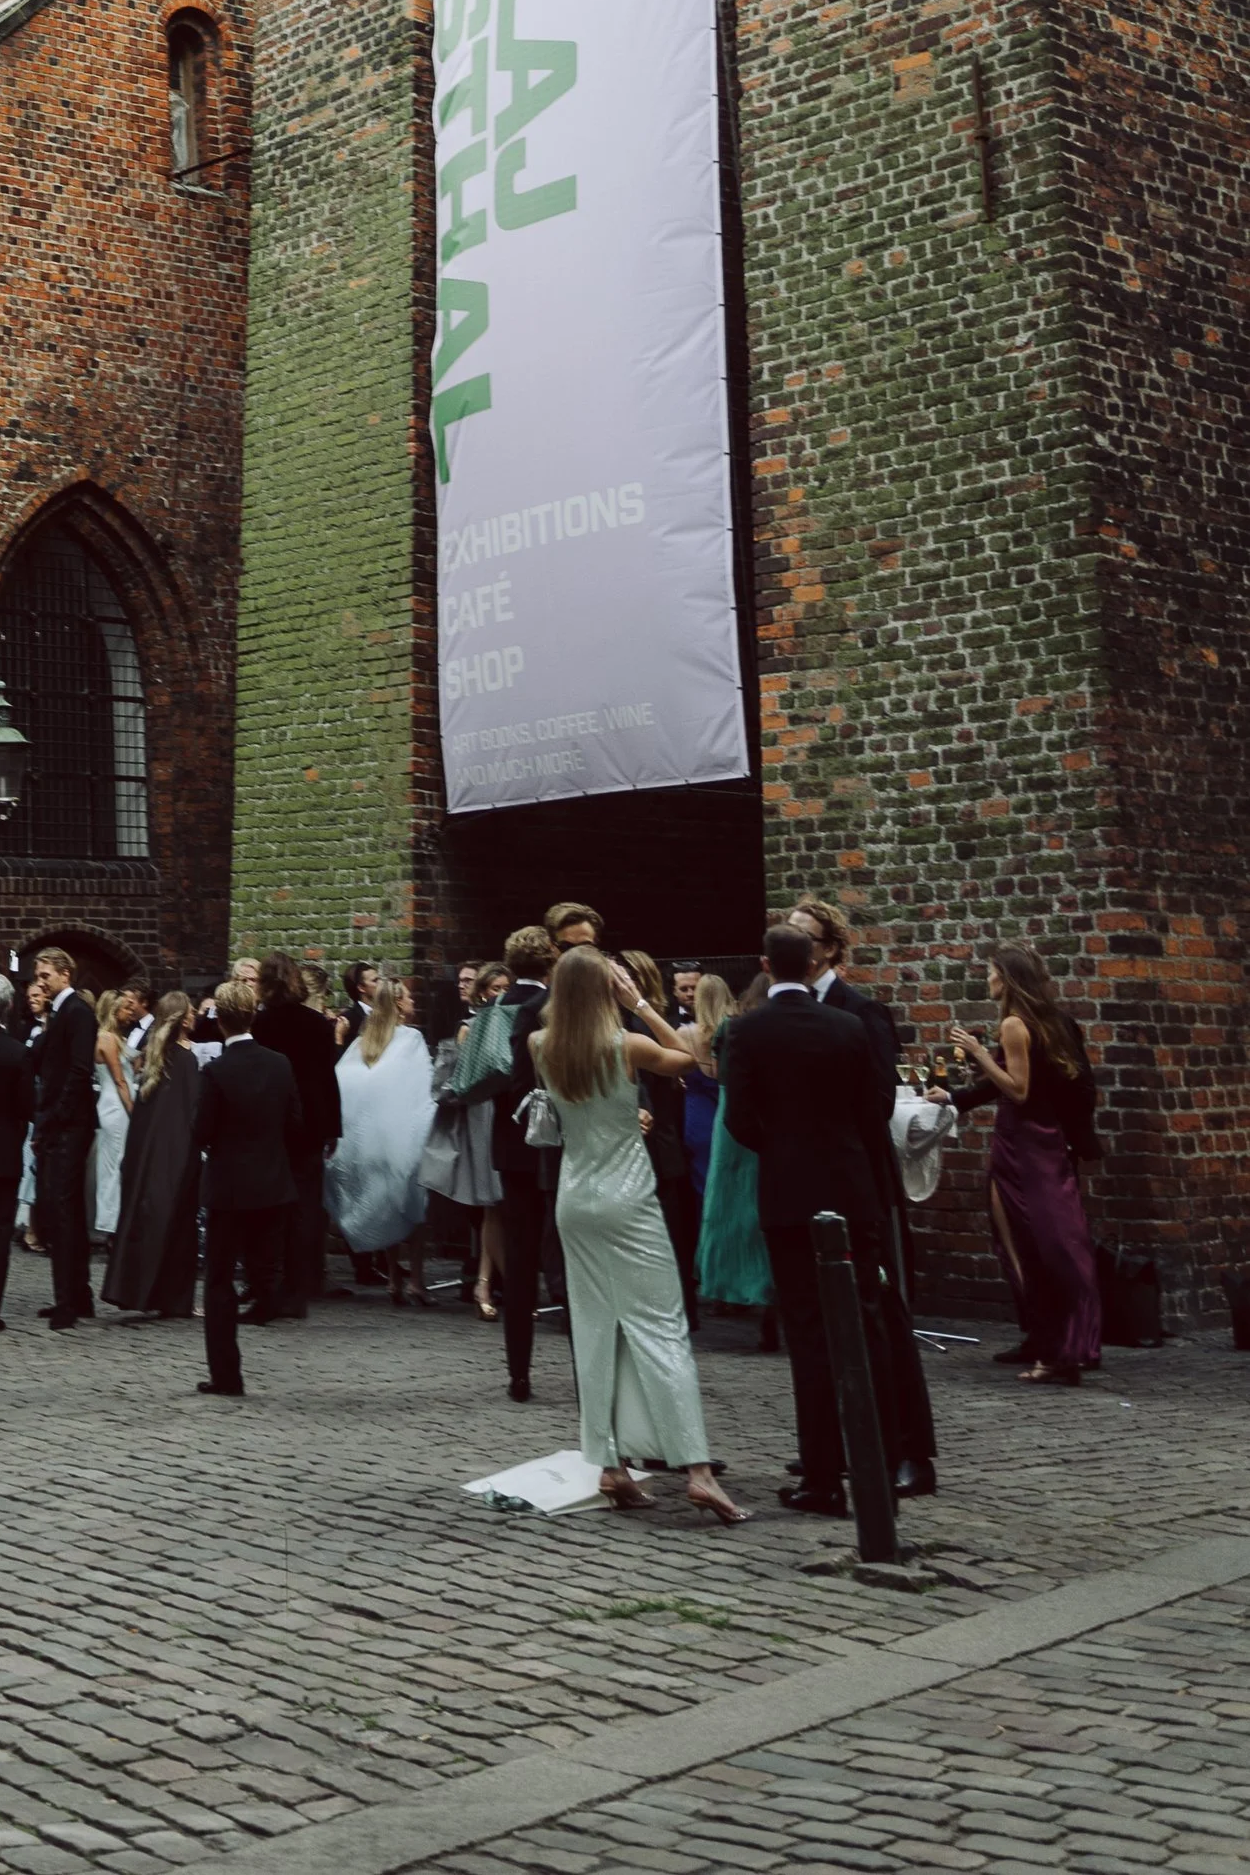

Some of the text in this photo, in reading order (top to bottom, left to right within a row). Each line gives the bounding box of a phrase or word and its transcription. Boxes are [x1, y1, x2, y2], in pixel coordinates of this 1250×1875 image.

[439, 481, 646, 573] EXHIBITIONS
[443, 570, 515, 637] CAFÉ
[445, 645, 524, 701] SHOP
[453, 732, 479, 755] ART
[604, 702, 655, 730] WINE
[455, 749, 586, 789] AND MUCH MORE
